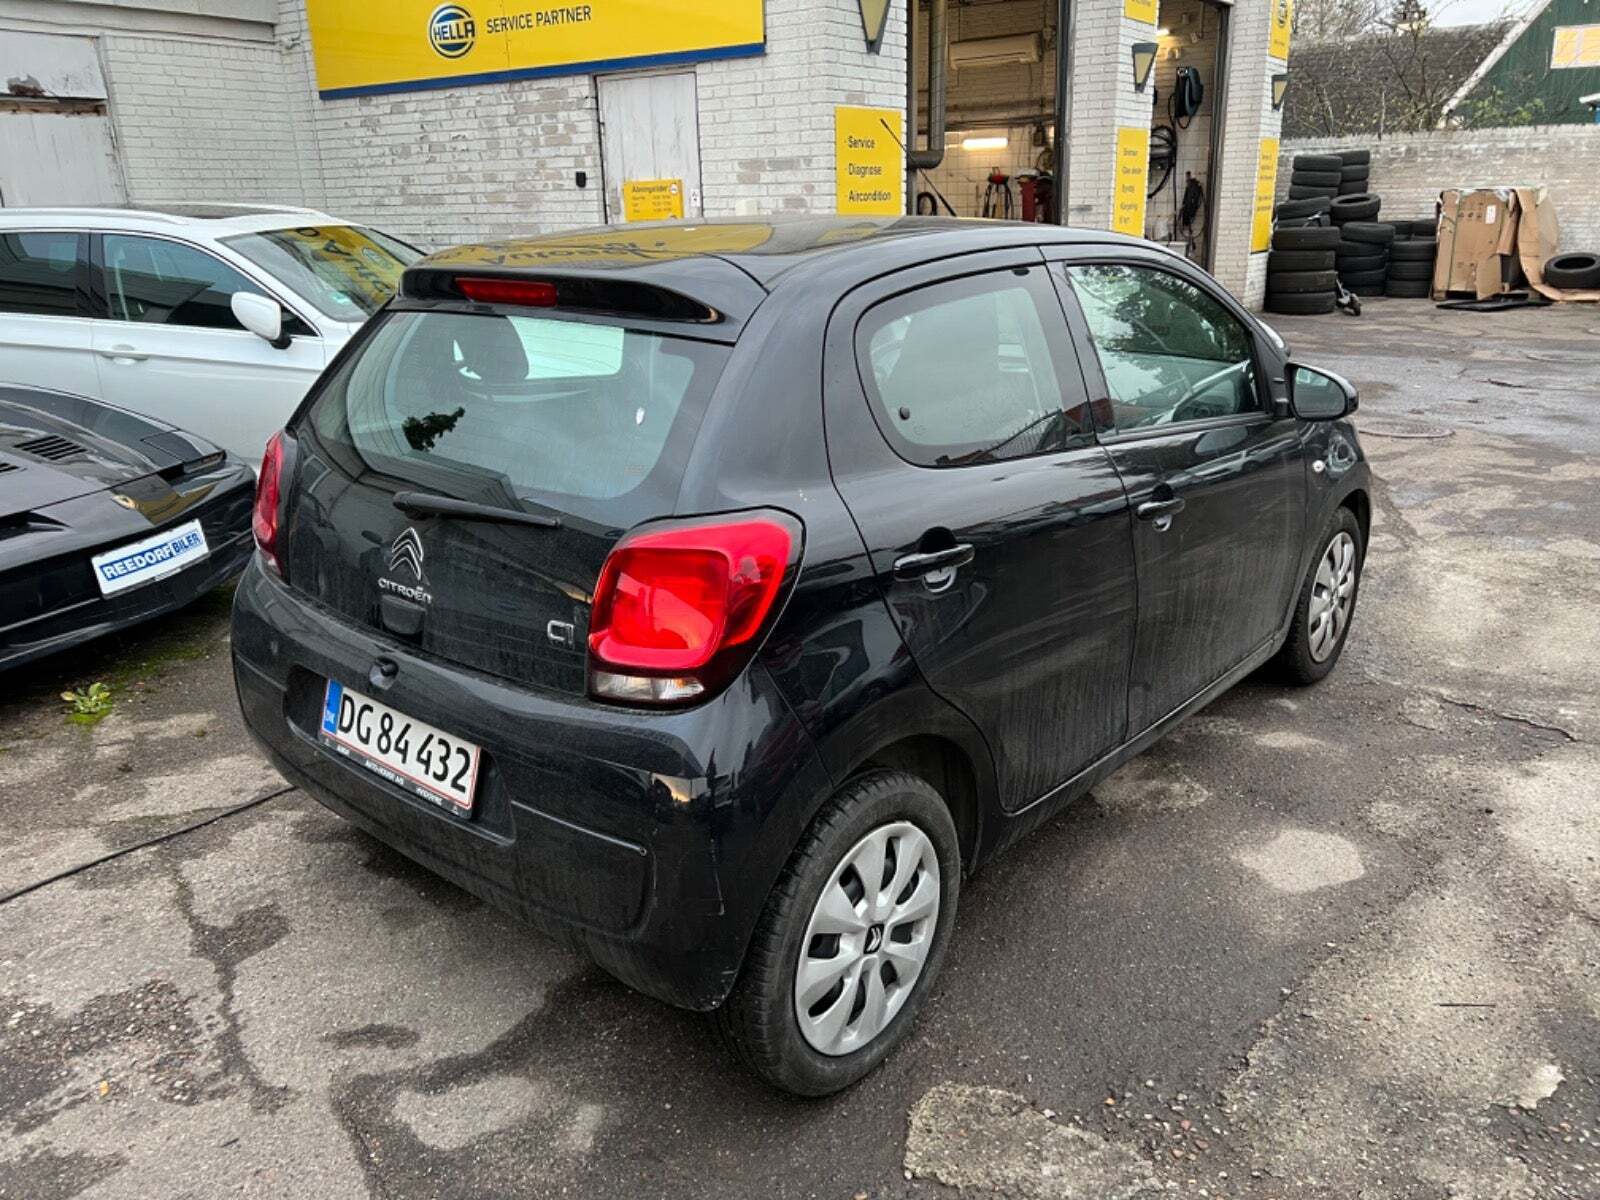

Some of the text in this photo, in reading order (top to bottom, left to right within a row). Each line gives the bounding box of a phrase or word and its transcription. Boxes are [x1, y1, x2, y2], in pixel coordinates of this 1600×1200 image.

[486, 5, 592, 34] SERVICE PARTNER
[433, 20, 475, 41] HELLA
[847, 136, 875, 149] Service
[848, 163, 882, 178] Diagnose
[848, 190, 891, 203] Aircondition
[103, 533, 200, 578] REEDORF BILER
[547, 619, 574, 645] C1
